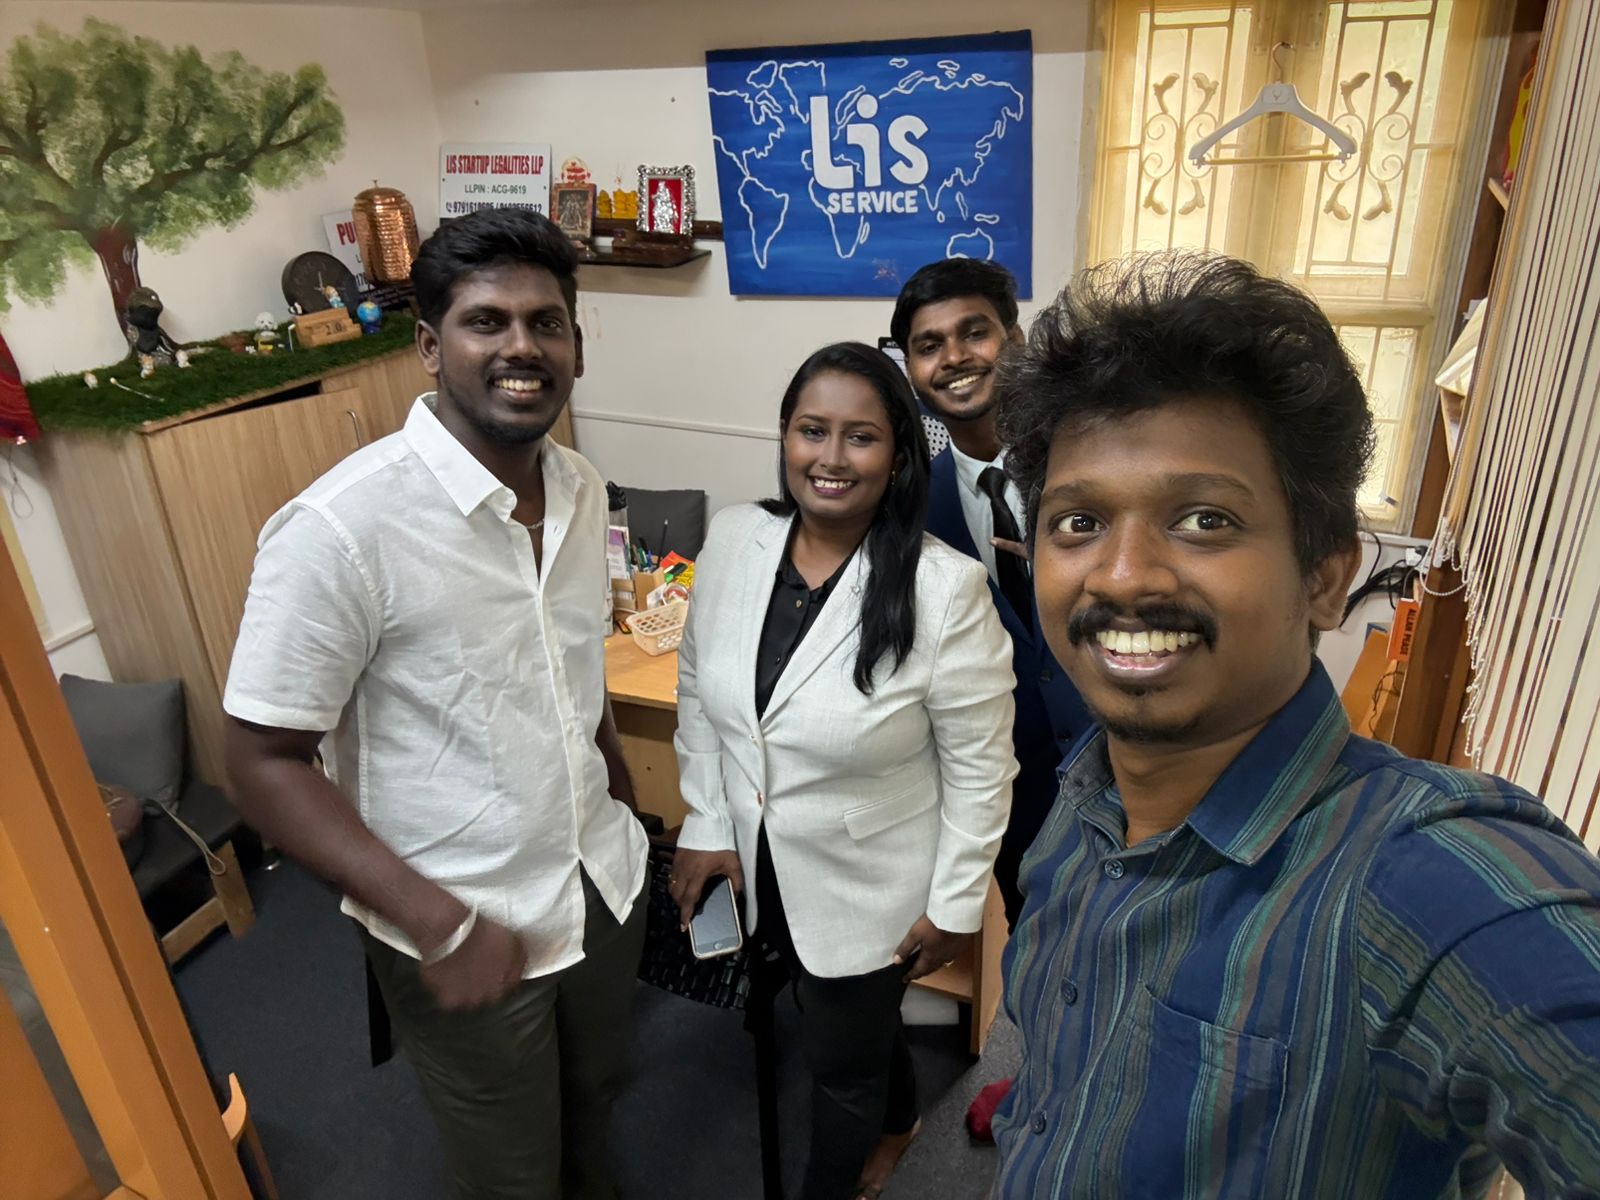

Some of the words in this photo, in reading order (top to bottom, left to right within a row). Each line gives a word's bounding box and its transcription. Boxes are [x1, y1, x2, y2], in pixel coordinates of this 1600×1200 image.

[446, 155, 457, 174] LIS
[458, 155, 490, 174] STARTUP
[491, 155, 530, 175] LEGALITIES
[531, 155, 544, 175] LLP
[464, 184, 486, 194] LLPIN
[826, 190, 919, 214] SERVICE
[336, 221, 357, 246] PU
